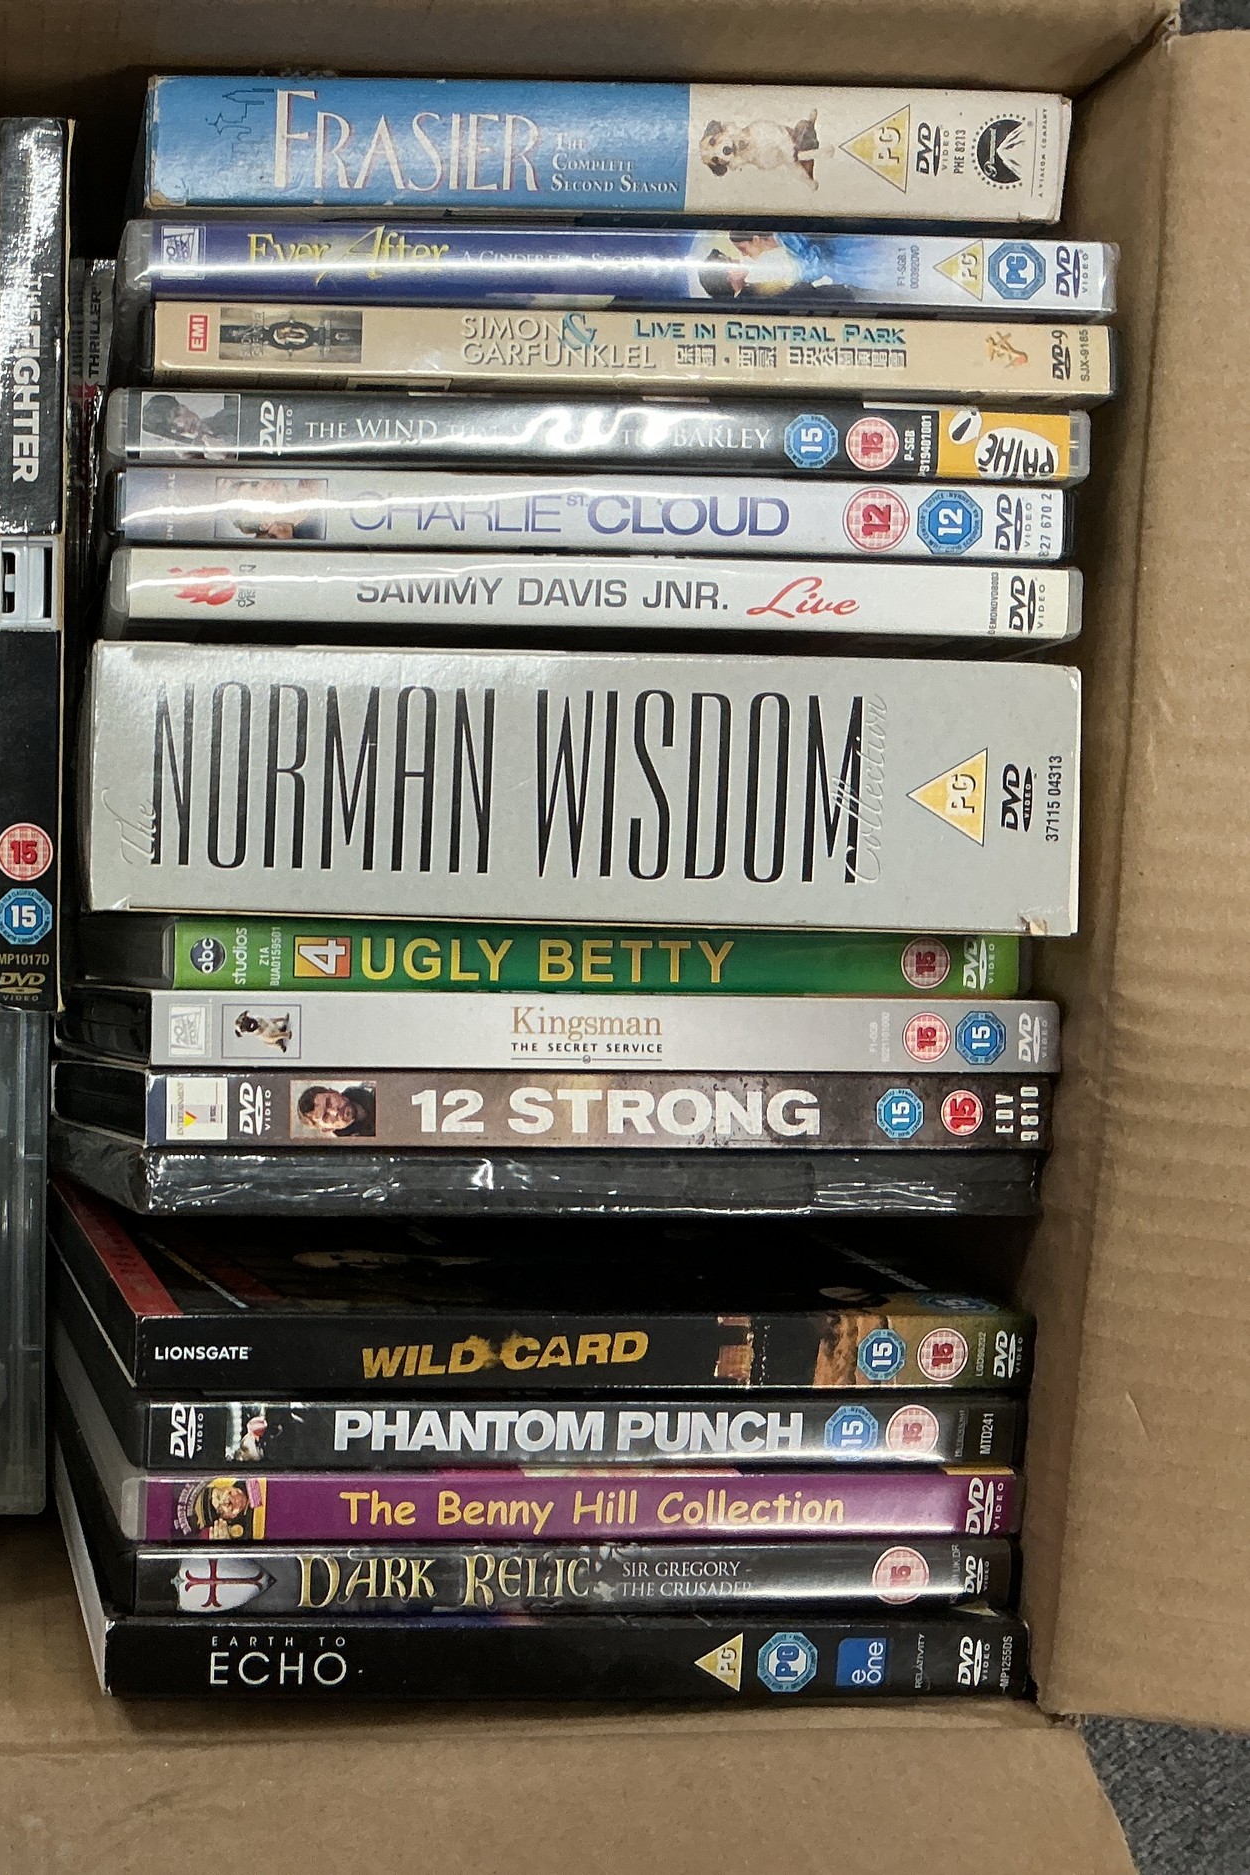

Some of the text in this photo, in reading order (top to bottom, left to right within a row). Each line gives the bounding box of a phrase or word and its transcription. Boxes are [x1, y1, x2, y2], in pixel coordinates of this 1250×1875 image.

[273, 89, 541, 192] FRASIER
[552, 152, 636, 172] COMPLETE
[551, 175, 679, 194] SECOND SEASON
[248, 226, 449, 285] Ever After
[191, 315, 206, 351] EMI
[461, 311, 598, 350] SIMON &
[635, 320, 686, 339] LIVE
[693, 322, 716, 339] IN
[844, 324, 907, 345] PARK
[462, 342, 657, 368] GARFUNKLEL
[1080, 329, 1090, 382] SJX-9185
[305, 422, 347, 438] THE
[355, 418, 438, 440] WIND
[673, 428, 774, 451] BARLEY
[349, 492, 562, 532] CHARLIE
[588, 495, 790, 536] CLOUD
[356, 576, 861, 619] SAMMY DAVIS JNR. Live
[151, 681, 863, 883] NORMAN WISDOM
[831, 693, 889, 884] Collection
[1045, 755, 1063, 842] 37115 04313
[201, 938, 215, 974] abc
[234, 927, 248, 985] studios
[297, 940, 347, 975] 4
[361, 937, 735, 983] UGLY BETTY
[510, 1006, 663, 1040] Kingsman
[511, 1042, 664, 1054] THE SECRET SERVICE
[411, 1087, 821, 1137] 12 STRONG
[154, 1346, 249, 1361] LIONSGATE
[362, 1330, 649, 1379] WILD CARD
[333, 1409, 804, 1452] PHANTOM PUNCH
[979, 1412, 994, 1456] MTD241
[340, 1489, 845, 1535] The Benny Hill Collection
[296, 1552, 590, 1611] DARK RELIC
[621, 1581, 655, 1597] THE
[622, 1561, 741, 1577] SIR GREGORY
[211, 1636, 346, 1647] EARTH TO
[915, 1633, 925, 1689] RELATIVITY
[210, 1652, 347, 1685] ECHO
